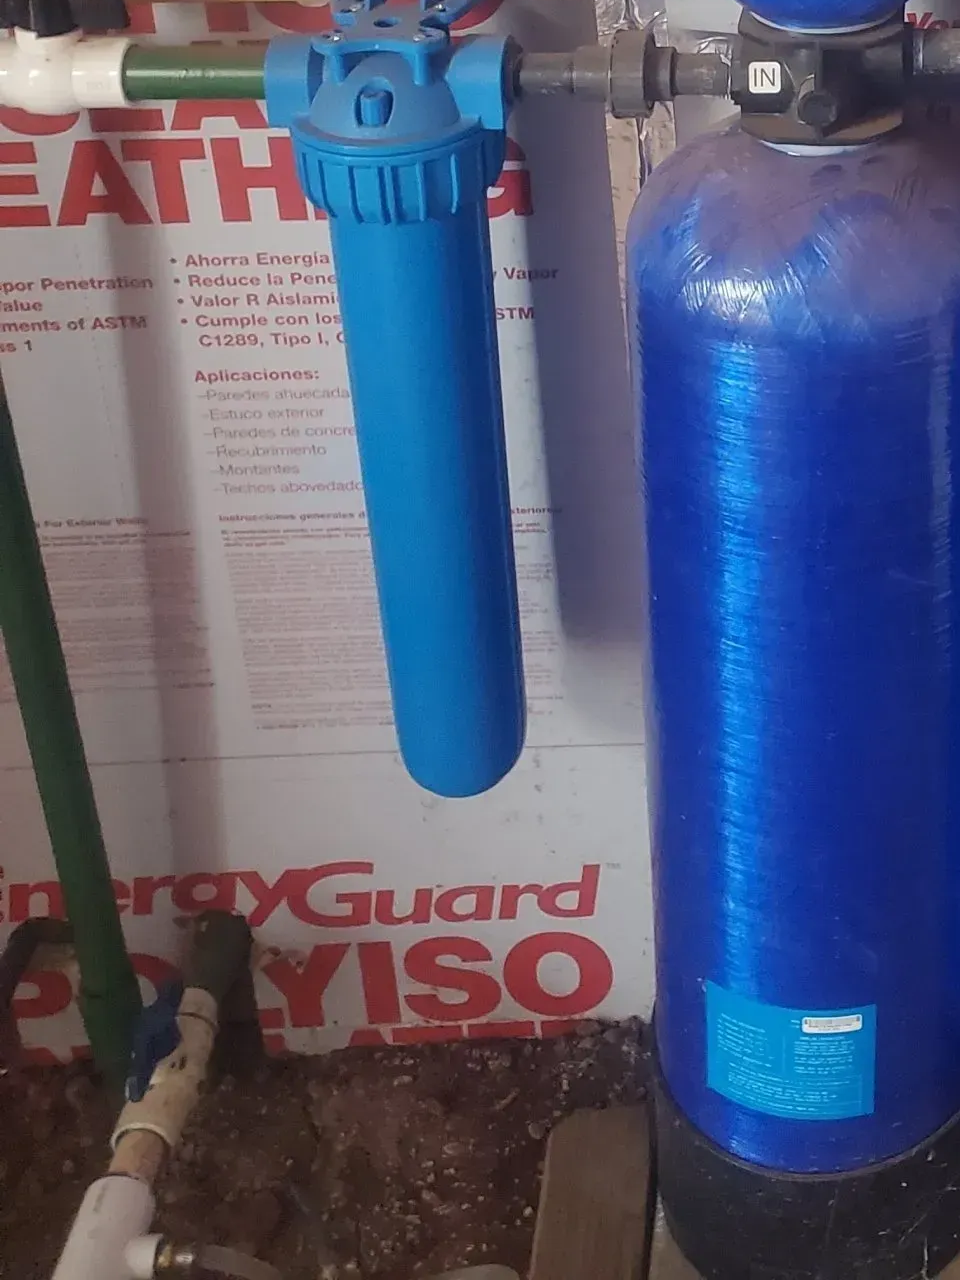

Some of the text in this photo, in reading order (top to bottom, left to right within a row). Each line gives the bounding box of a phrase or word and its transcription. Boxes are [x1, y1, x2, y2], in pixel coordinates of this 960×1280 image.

[754, 67, 775, 87] IN
[185, 251, 330, 268] Ahorra Energía
[40, 276, 153, 291] Penetration
[188, 274, 261, 287] Reduce
[267, 273, 284, 285] la
[190, 294, 240, 307] Valor
[246, 293, 259, 305] R
[67, 317, 86, 331] of
[91, 316, 148, 330] ASTM
[195, 314, 268, 329] Cumple
[274, 315, 309, 325] con
[24, 340, 33, 351] 1
[199, 334, 264, 348] C1289,
[269, 332, 311, 348] Tipo
[195, 369, 320, 384] Aplicaciones:
[280, 426, 300, 437] de
